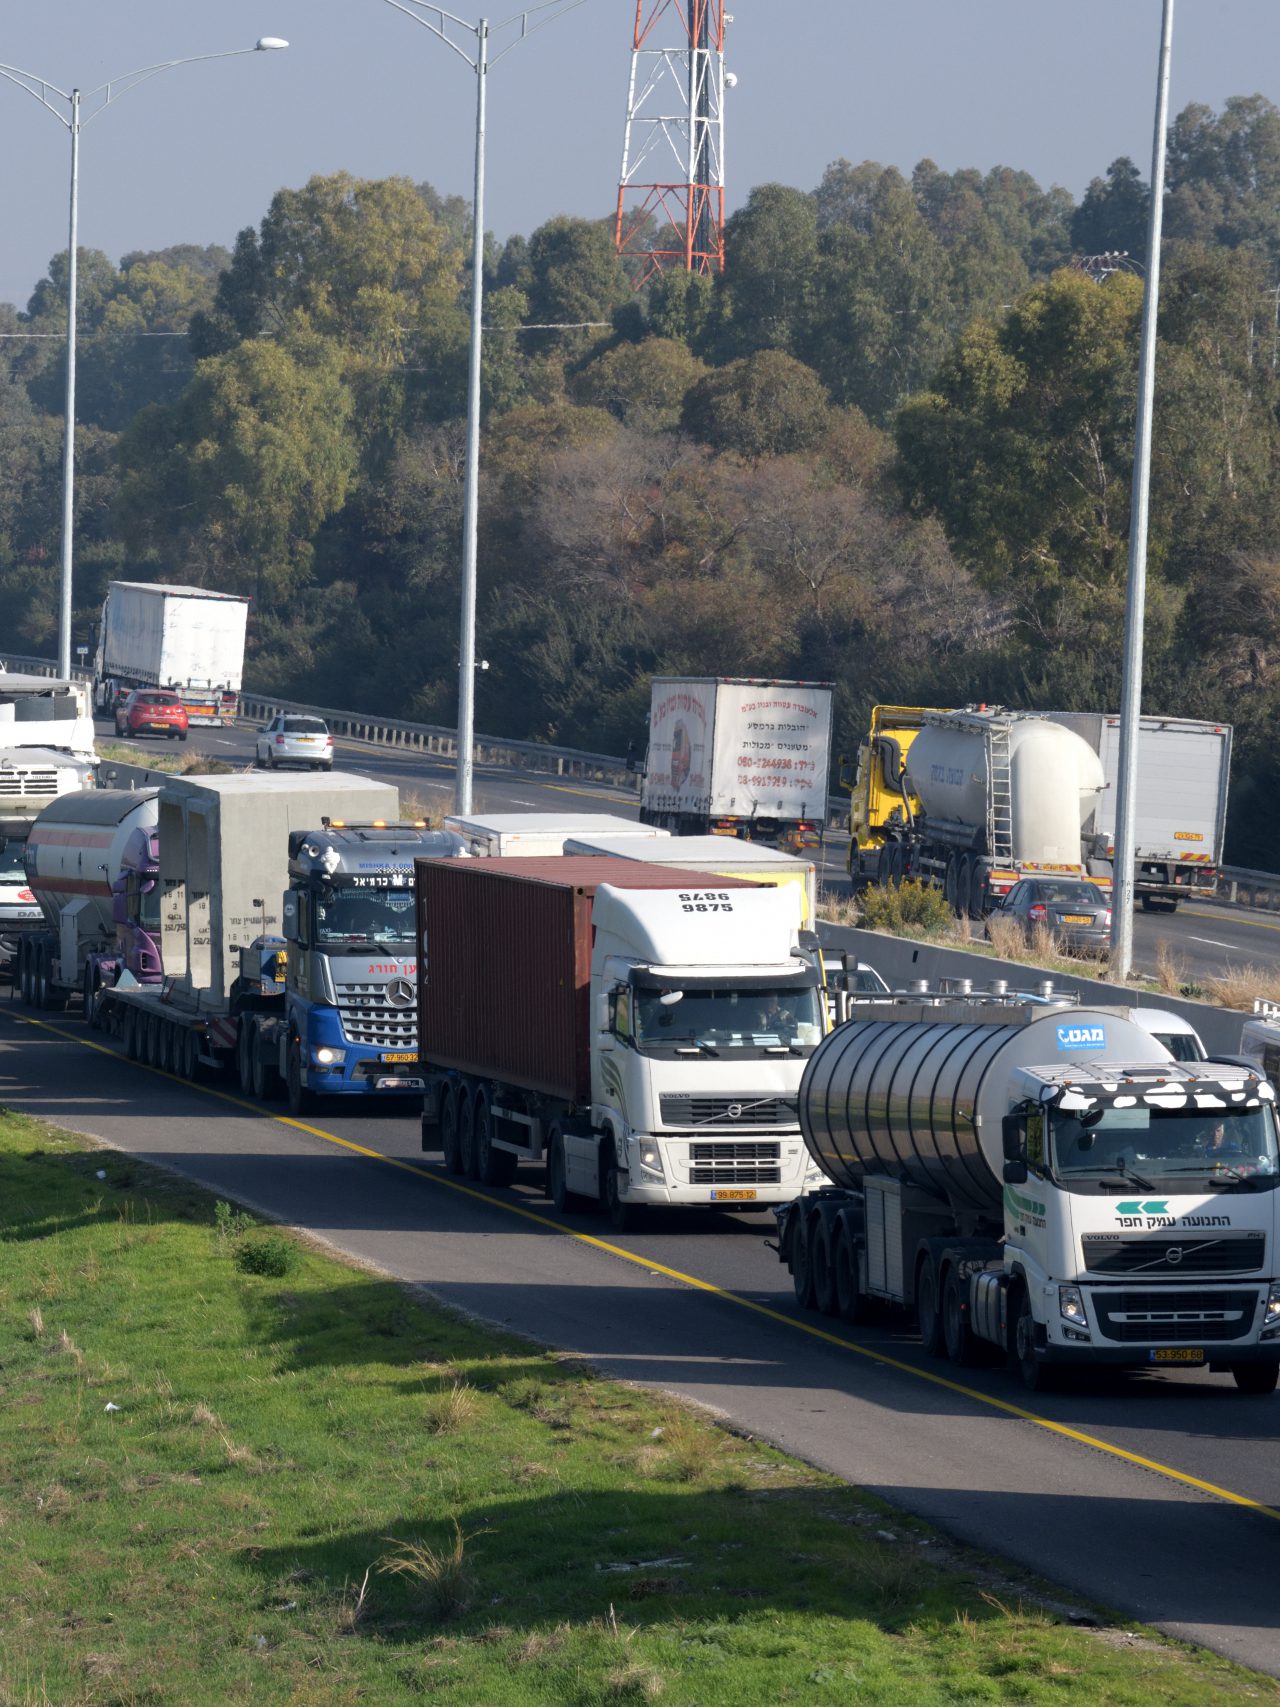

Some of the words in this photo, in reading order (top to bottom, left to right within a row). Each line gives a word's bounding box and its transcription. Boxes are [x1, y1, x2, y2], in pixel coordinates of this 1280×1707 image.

[353, 876, 388, 887] כרמיאל
[681, 903, 734, 913] 9875
[368, 963, 398, 974] חורג
[1114, 1217, 1143, 1228] חפר
[1146, 1216, 1177, 1229] עמק
[1181, 1215, 1232, 1227] התנועה
